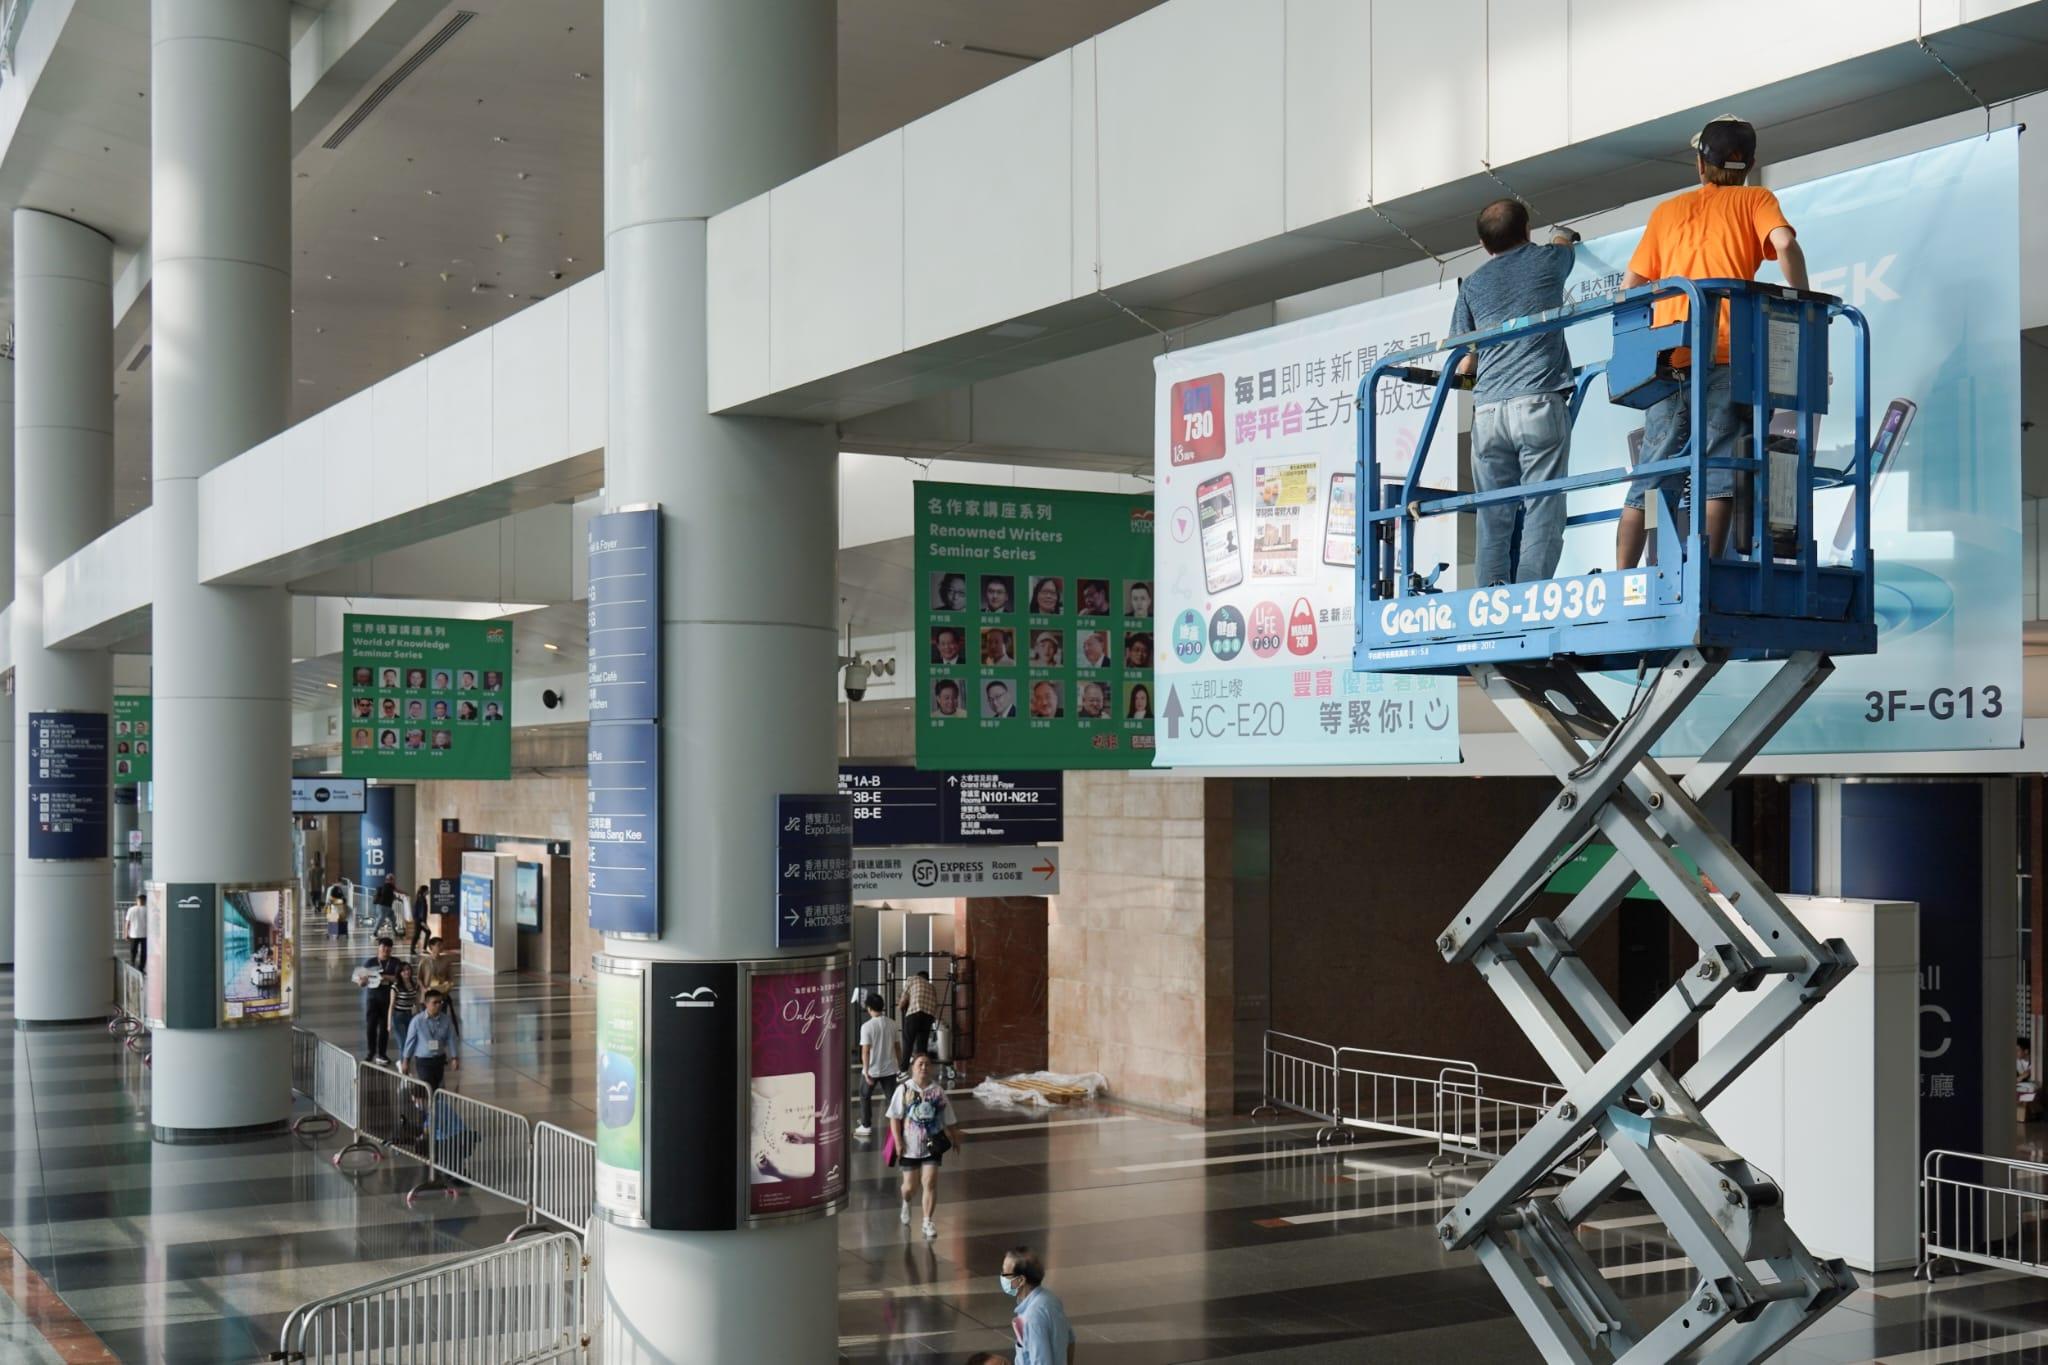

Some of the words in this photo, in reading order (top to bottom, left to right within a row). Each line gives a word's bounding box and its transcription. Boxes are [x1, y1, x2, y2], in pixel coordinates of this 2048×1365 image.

[1235, 377, 1431, 444] 跨平台全方放送
[928, 498, 1052, 521] 名作家講座系列
[929, 523, 1006, 541] Renowned
[1010, 528, 1063, 543] Writers
[929, 544, 990, 559] Seminar
[993, 545, 1037, 561] Series
[1468, 577, 1607, 628] GS-1930
[1381, 598, 1453, 636] Genie
[352, 637, 382, 647] World
[385, 639, 395, 647] of
[397, 639, 450, 650] Knowledge
[352, 649, 392, 658] Seminar
[394, 650, 423, 660] Series
[1865, 685, 2003, 722] 3F-G13
[1189, 702, 1285, 738] 5C-E20
[854, 775, 881, 787] 1A-B
[853, 791, 882, 803] 3B-E
[981, 791, 1039, 803] N101-N212
[853, 807, 882, 819] 5B-E
[626, 829, 642, 840] Kee
[805, 825, 824, 836] Expo
[367, 837, 382, 846] Hall
[366, 848, 384, 865] 1B
[940, 862, 983, 872] EXPRESS
[992, 861, 1016, 870] Room
[853, 871, 868, 879] ook
[870, 871, 902, 881] Delivery
[917, 866, 933, 881] SF
[992, 871, 1023, 881] G106室
[853, 881, 878, 889] ervice
[783, 999, 815, 1034] Only
